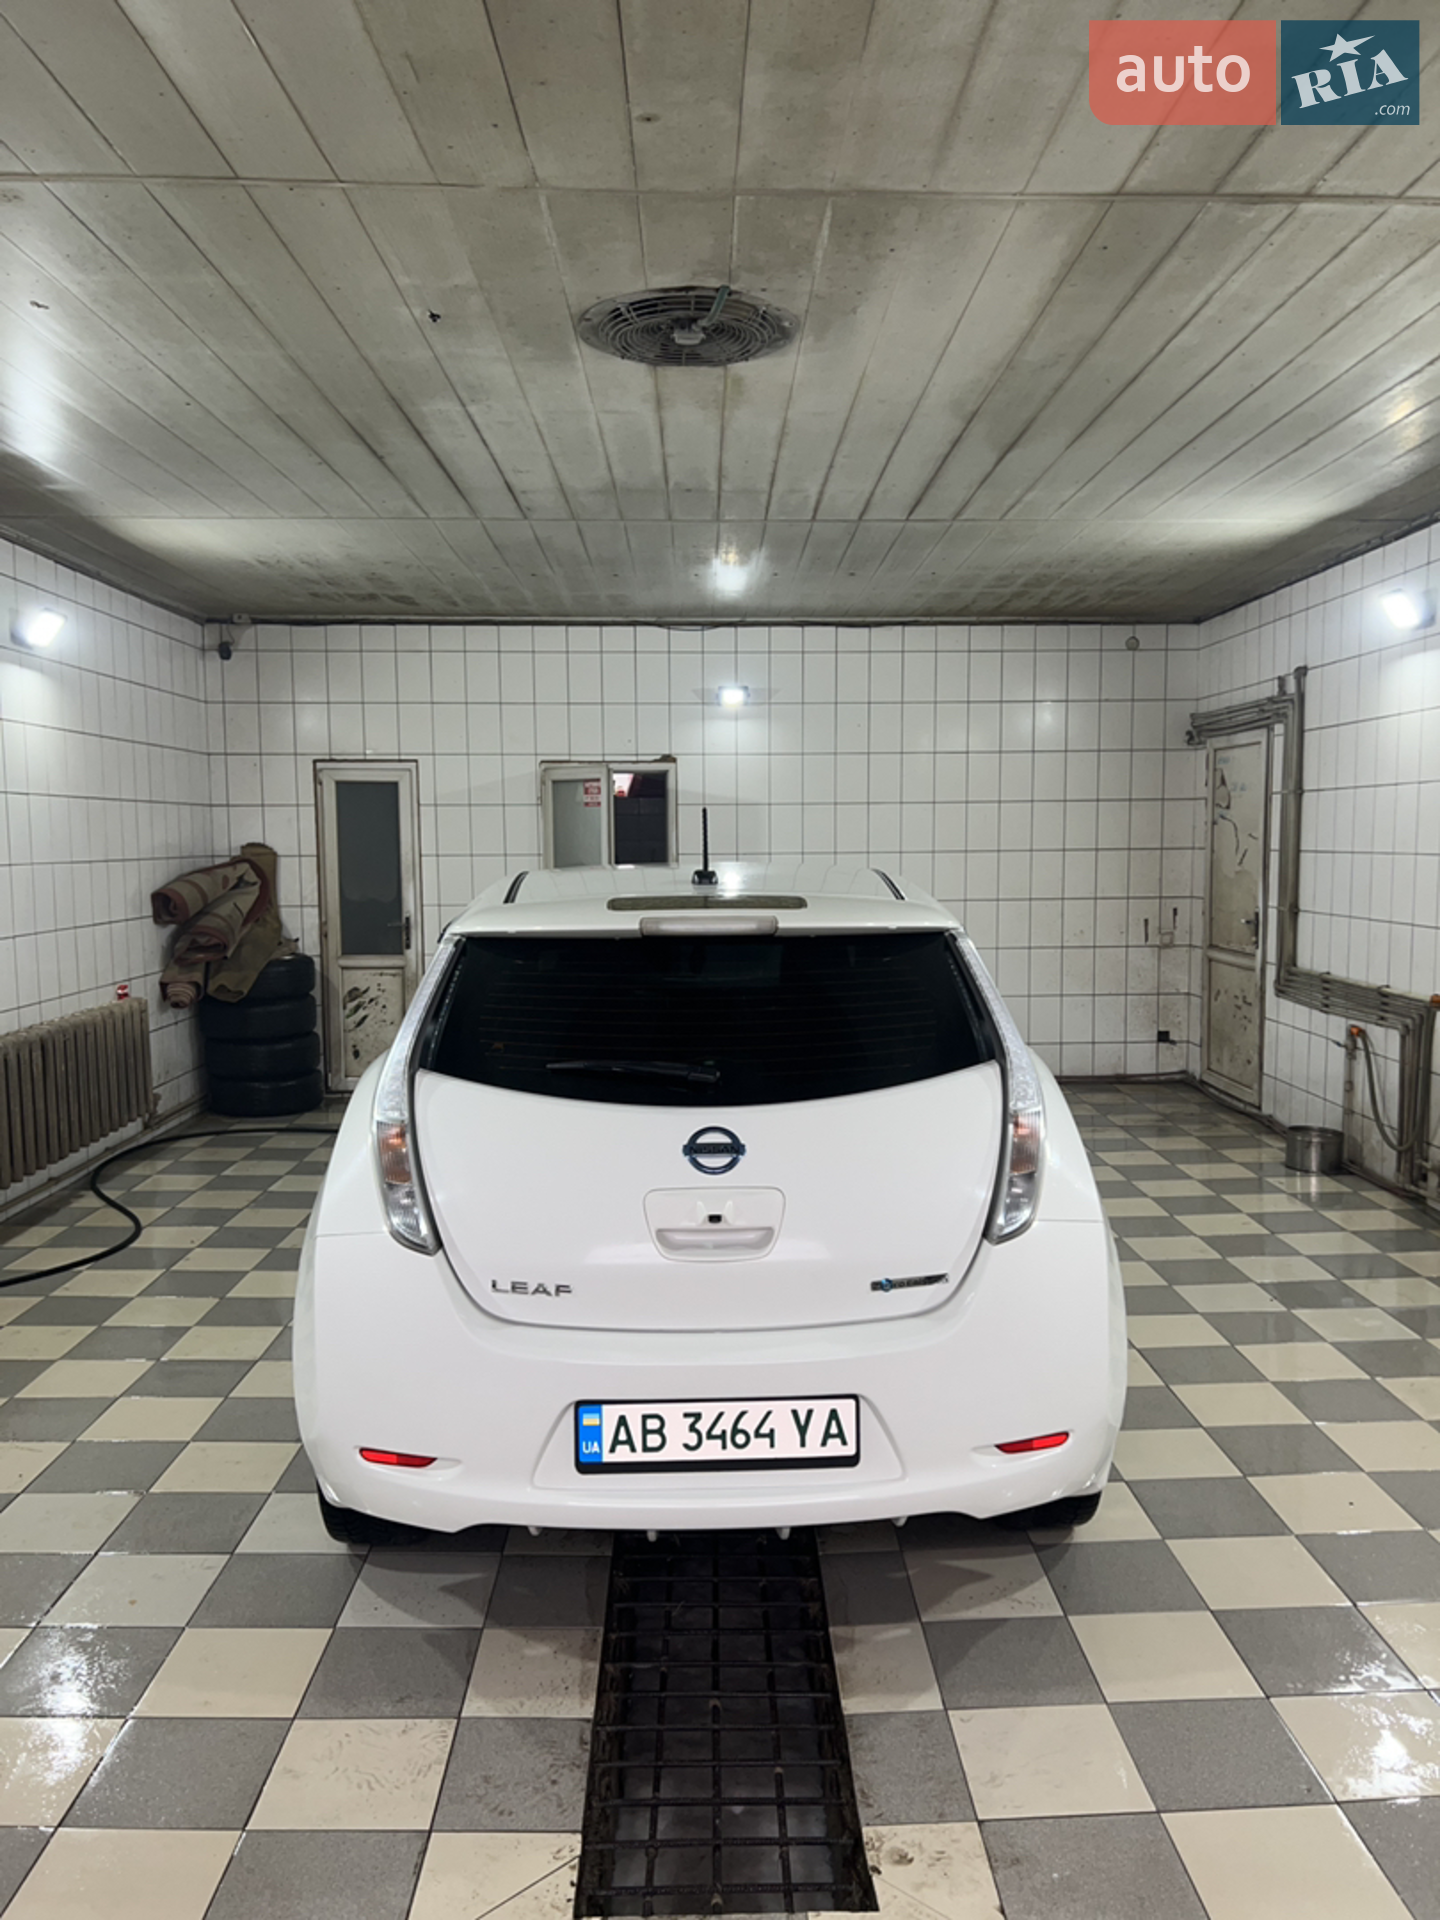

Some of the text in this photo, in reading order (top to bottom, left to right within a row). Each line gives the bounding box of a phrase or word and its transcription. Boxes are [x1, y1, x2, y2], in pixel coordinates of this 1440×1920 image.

[491, 1279, 572, 1297] LEAF
[608, 1408, 849, 1454] AB 3464 YA
[582, 1440, 601, 1455] UA
